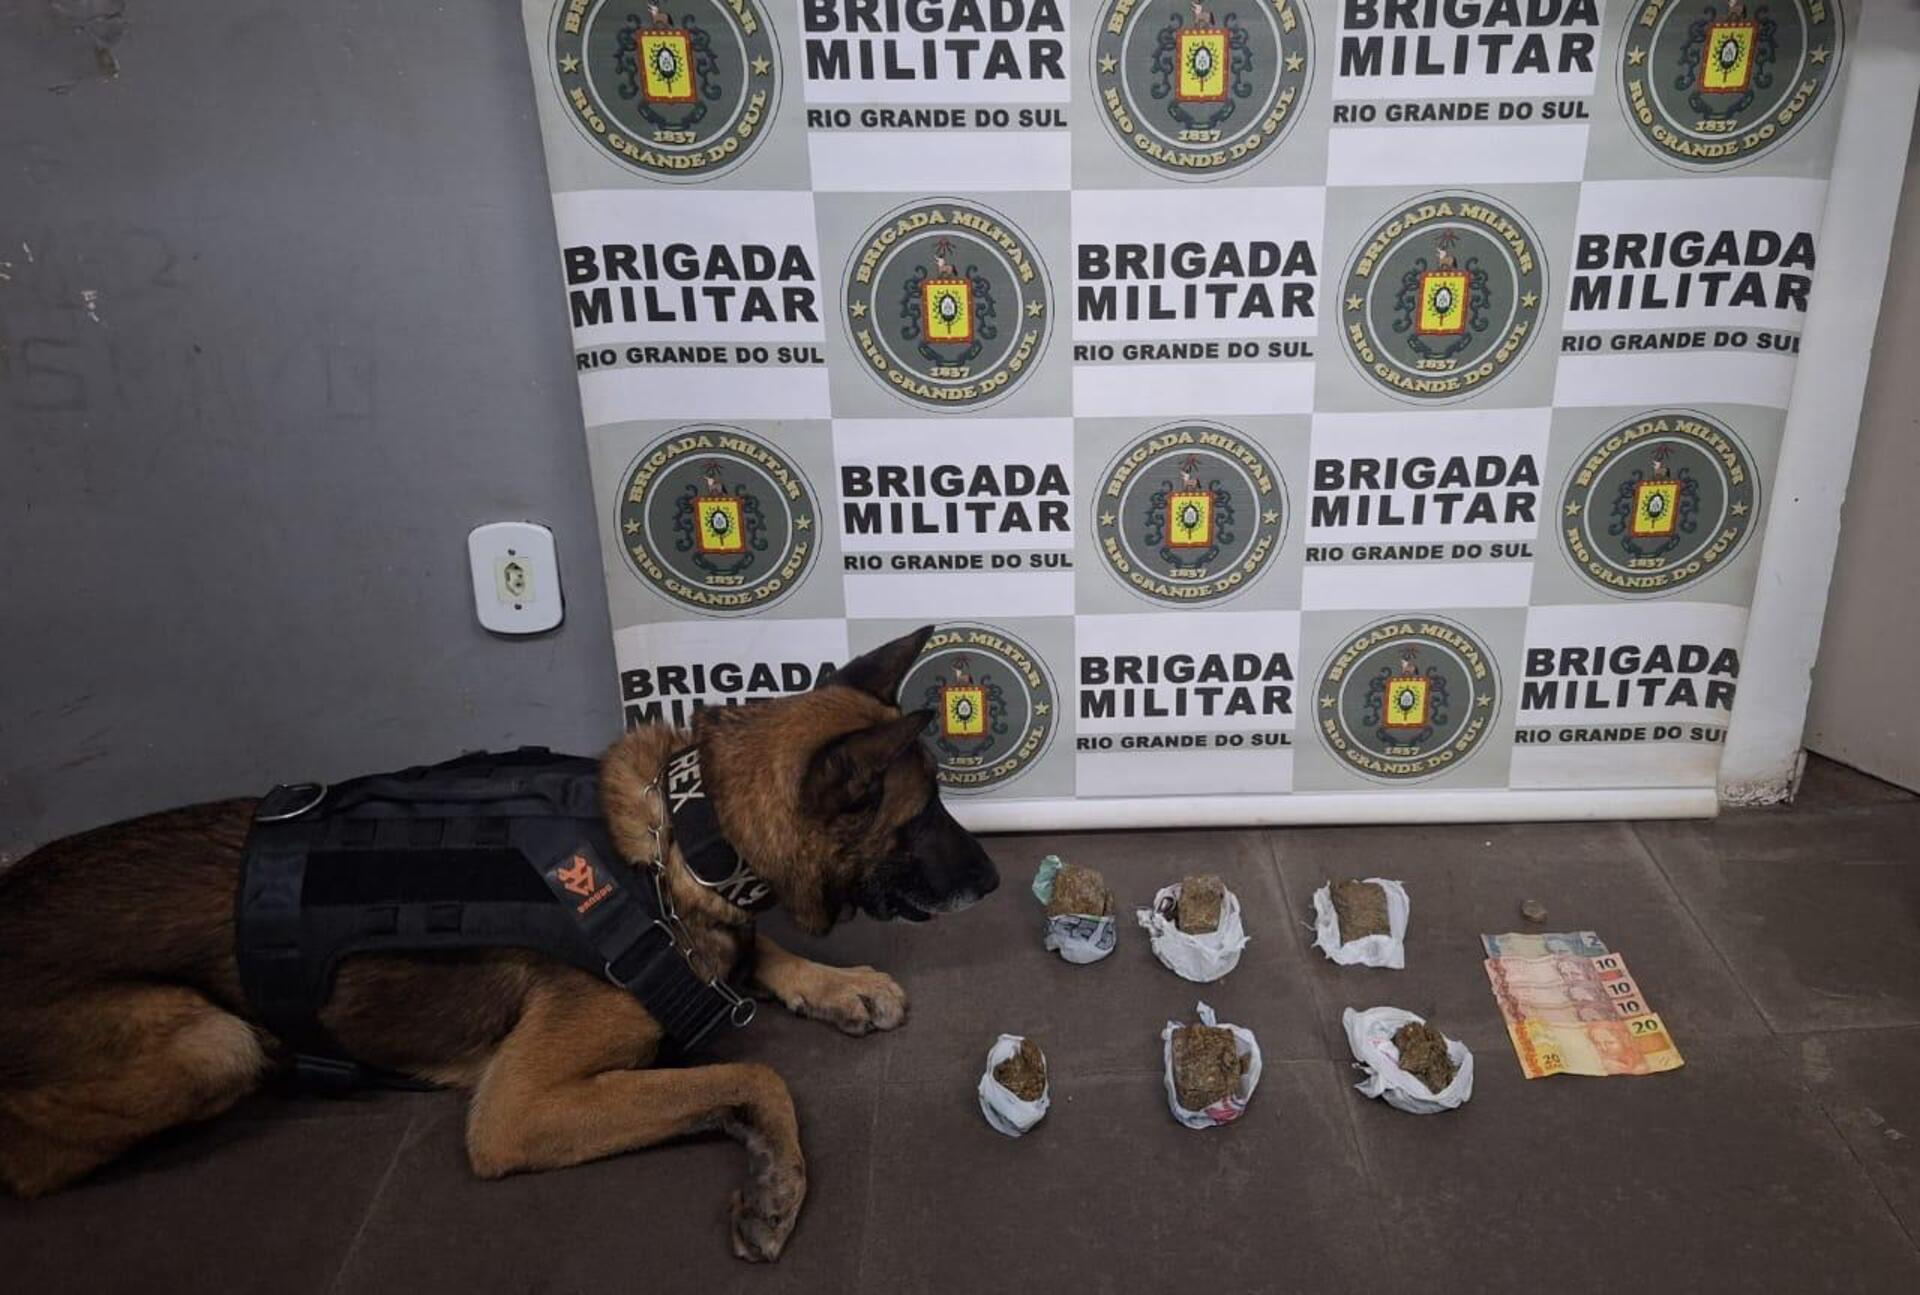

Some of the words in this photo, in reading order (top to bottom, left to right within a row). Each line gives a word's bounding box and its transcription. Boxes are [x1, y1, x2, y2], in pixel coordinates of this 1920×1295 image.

[803, 0, 1065, 33] BRIGADA
[1343, 0, 1600, 30] BRIGADA
[805, 39, 1066, 80] MILITAR
[1340, 32, 1595, 77] MILITAR
[570, 87, 606, 134] RIO
[608, 133, 706, 168] GRANDE
[709, 137, 738, 161] DO
[737, 90, 766, 137] SUL
[806, 109, 852, 128] RIO
[860, 109, 966, 128] GRANDE
[975, 109, 1010, 128] DO
[1018, 109, 1068, 127] SUL
[1104, 87, 1134, 133] RIO
[1135, 133, 1227, 167] GRANDE
[1231, 135, 1261, 159] DO
[1262, 87, 1297, 135] SUL
[1333, 104, 1376, 123] RIO
[1385, 102, 1490, 122] GRANDE
[1498, 102, 1533, 121] DO
[1541, 100, 1590, 120] SUL
[1629, 80, 1653, 125] RIO
[1652, 125, 1739, 157] GRANDE
[1743, 125, 1775, 149] DO
[1778, 79, 1817, 125] SUL
[653, 131, 697, 144] 1837
[1178, 130, 1222, 142] 1837
[856, 209, 948, 284] BRIGADA
[953, 211, 1035, 283] MILITAR
[1356, 202, 1455, 277] BRIGADA
[1460, 203, 1535, 275] MILITAR
[1575, 229, 1816, 271] BRIGADA
[563, 243, 815, 286] BRIGADA
[1078, 240, 1317, 280] BRIGADA
[569, 286, 819, 329] MILITAR
[1078, 282, 1315, 321] MILITAR
[1569, 271, 1813, 313] MILITAR
[575, 348, 618, 371] RIO
[625, 346, 728, 364] GRANDE
[735, 346, 769, 364] DO
[777, 346, 825, 364] SUL
[1073, 344, 1114, 361] RIO
[1122, 342, 1219, 361] GRANDE
[1228, 342, 1260, 358] DO
[1268, 341, 1314, 358] SUL
[1349, 323, 1374, 363] RIO
[1375, 362, 1461, 393] GRANDE
[1464, 362, 1494, 385] DO
[1496, 321, 1529, 363] SUL
[1561, 335, 1602, 352] RIO
[1610, 331, 1707, 351] GRANDE
[1713, 331, 1749, 348] DO
[857, 329, 887, 371] RIO
[889, 369, 977, 400] GRANDE
[980, 371, 1009, 390] DO
[1009, 329, 1038, 371] SUL
[629, 435, 714, 503] BRIGADA
[719, 436, 802, 501] MILITAR
[1107, 431, 1195, 498] BRIGADA
[1200, 432, 1273, 496] MILITAR
[1314, 454, 1540, 491] BRIGADA
[1575, 419, 1670, 488] BRIGADA
[1675, 419, 1745, 486] MILITAR
[841, 464, 1070, 498] BRIGADA
[843, 500, 1070, 534] MILITAR
[1311, 491, 1536, 528] MILITAR
[843, 555, 883, 571] RIO
[890, 554, 984, 570] GRANDE
[991, 554, 1022, 569] DO
[1029, 553, 1073, 568] SUL
[1104, 536, 1129, 573] RIO
[1130, 572, 1213, 599] GRANDE
[1215, 572, 1243, 593] DO
[1243, 535, 1273, 573] SUL
[1306, 547, 1344, 562] RIO
[1351, 544, 1444, 561] GRANDE
[1451, 544, 1482, 559] DO
[1489, 543, 1533, 559] SUL
[1567, 527, 1591, 563] RIO
[1589, 562, 1669, 588] GRANDE
[1672, 562, 1701, 581] DO
[1703, 527, 1738, 563] SUL
[633, 545, 662, 580] RIO
[665, 578, 752, 606] GRANDE
[755, 579, 782, 600] DO
[781, 542, 808, 580] SUL
[969, 632, 1041, 689] MILITAR
[1080, 652, 1294, 685] BRIGADA
[1328, 623, 1415, 682] BRIGADA
[1420, 623, 1488, 680] MILITAR
[1525, 644, 1740, 679] BRIGADA
[1080, 685, 1292, 719] MILITAR
[1521, 677, 1737, 712] MILITAR
[936, 770, 991, 783] ANDE
[992, 758, 1018, 777] DO
[1018, 725, 1045, 760] SUL
[1076, 736, 1113, 751] RIO
[1120, 734, 1207, 749] GRANDE
[1214, 733, 1244, 747] DO
[1250, 733, 1292, 747] SUL
[1323, 719, 1346, 750] RIO
[1347, 749, 1425, 775] GRANDE
[1427, 750, 1454, 767] DO
[1455, 717, 1485, 751] SUL
[1514, 729, 1552, 744] RIO
[1558, 726, 1647, 743] GRANDE
[1652, 725, 1683, 741] DO
[668, 749, 706, 814] REX
[1596, 958, 1617, 970] 10
[1609, 982, 1631, 995] 10
[1617, 1001, 1640, 1013] 10
[1631, 1019, 1658, 1034] 20
